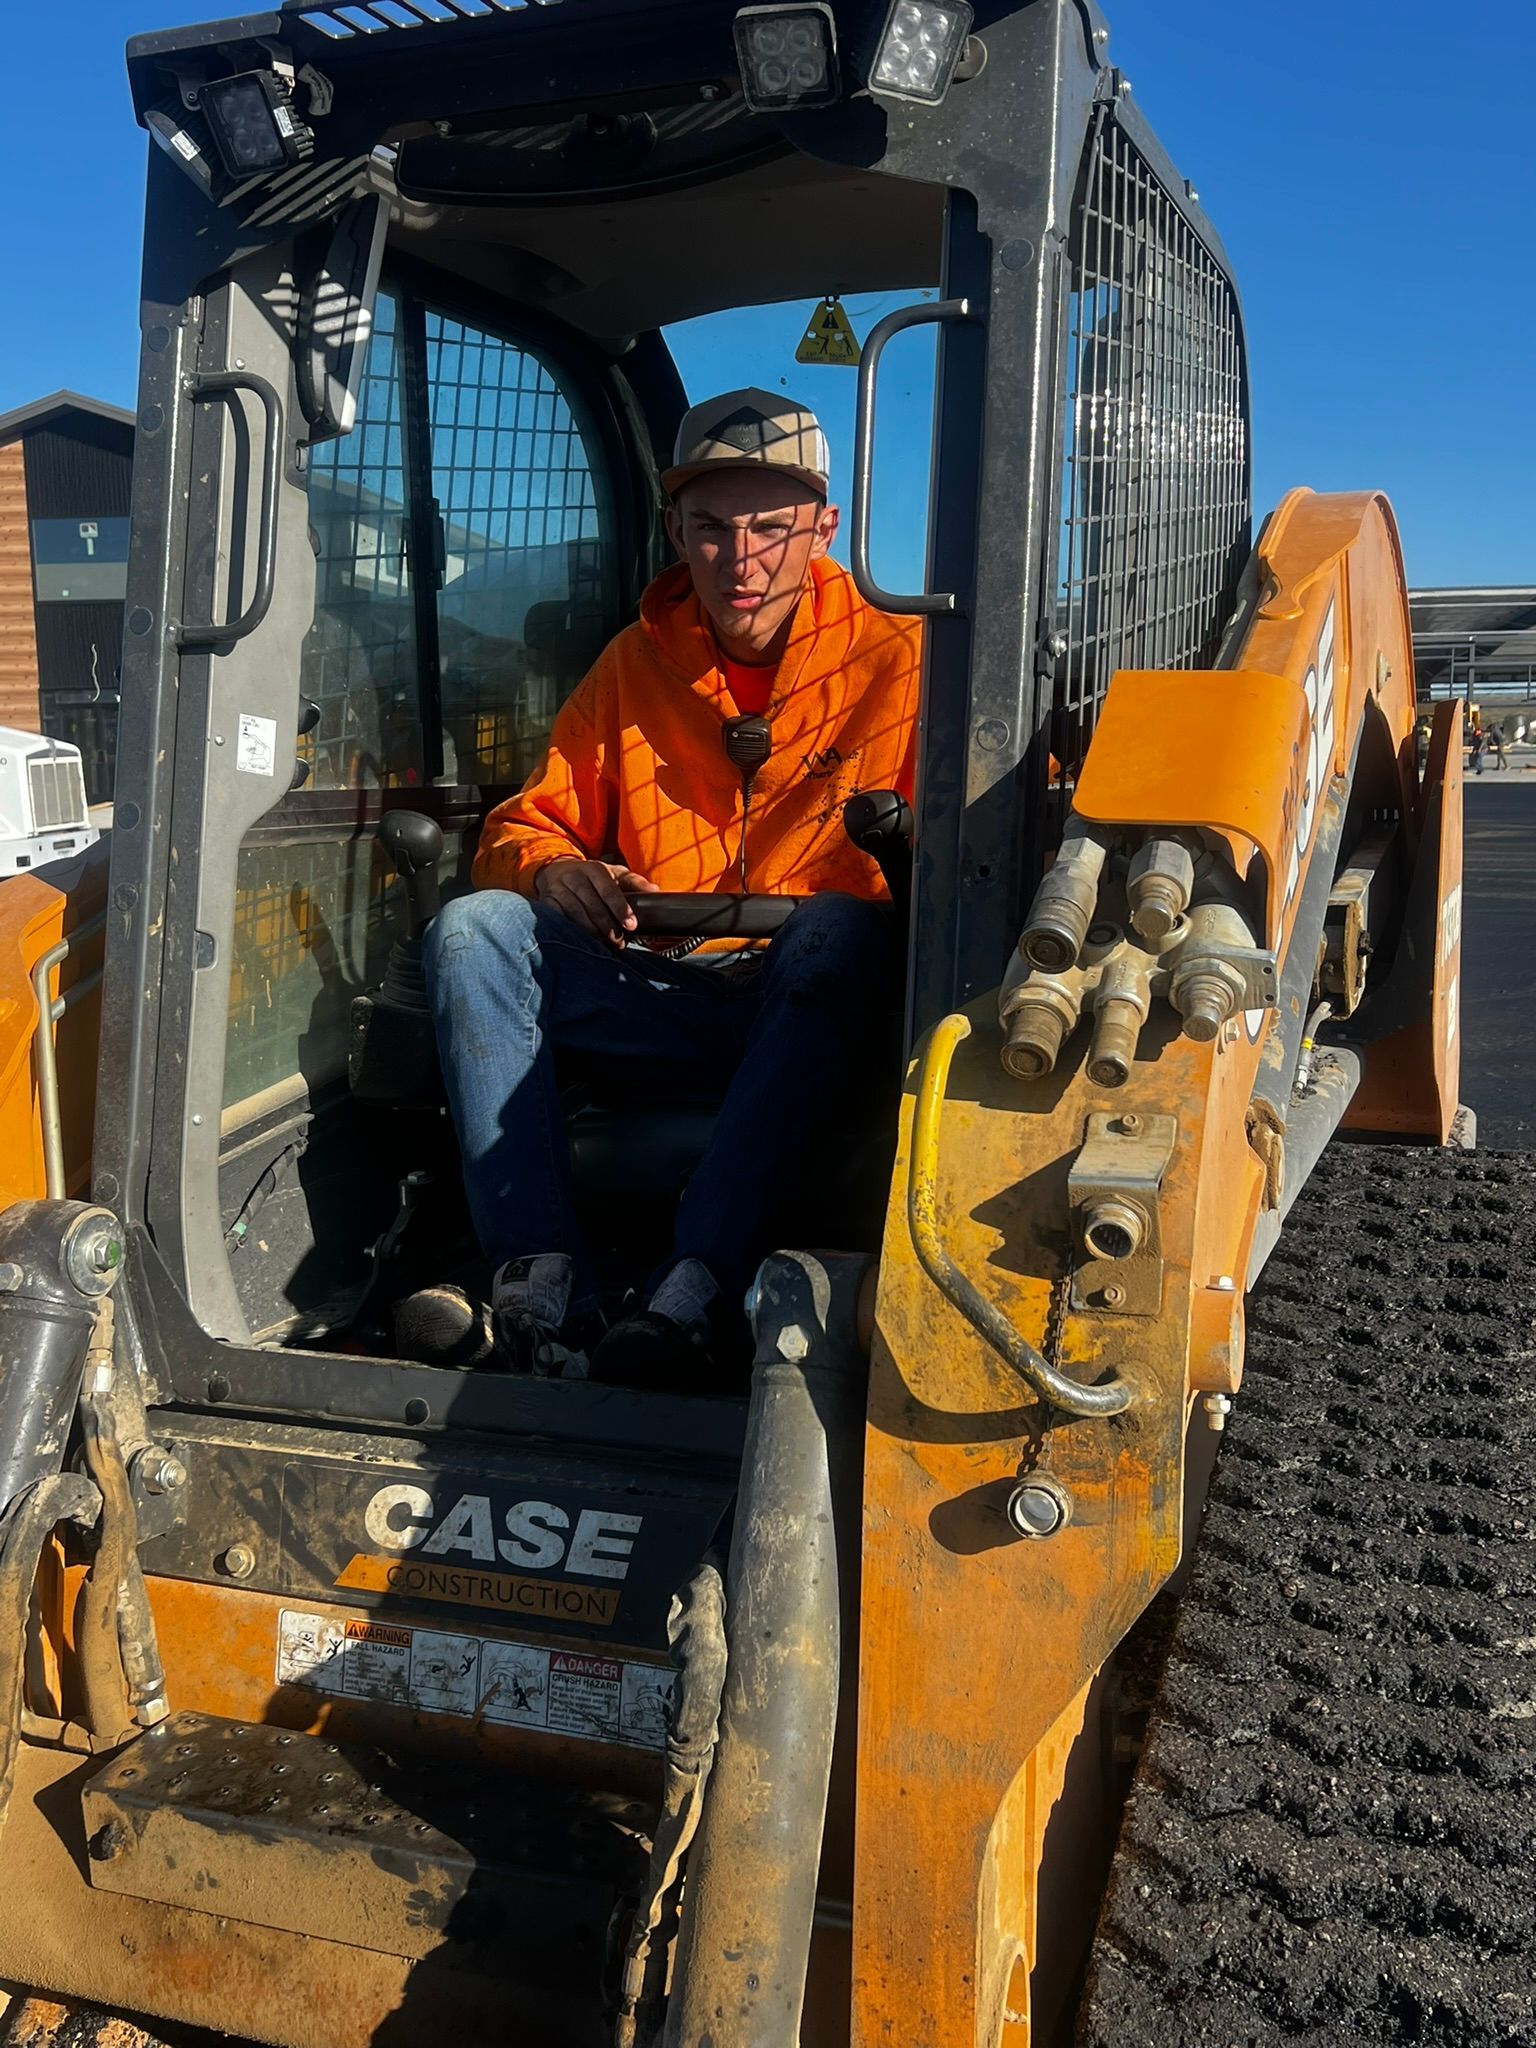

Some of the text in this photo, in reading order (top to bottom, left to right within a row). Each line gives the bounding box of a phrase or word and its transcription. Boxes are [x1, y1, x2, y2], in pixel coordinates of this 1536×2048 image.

[365, 1484, 643, 1580] CASE
[386, 1564, 608, 1618] CONSTRUCTION
[359, 1625, 410, 1645] WARNING
[352, 1641, 370, 1652] FALL
[372, 1644, 405, 1657] HAZARD
[568, 1658, 618, 1679] DANGER
[552, 1673, 619, 1692] CRUSH HAZARD
